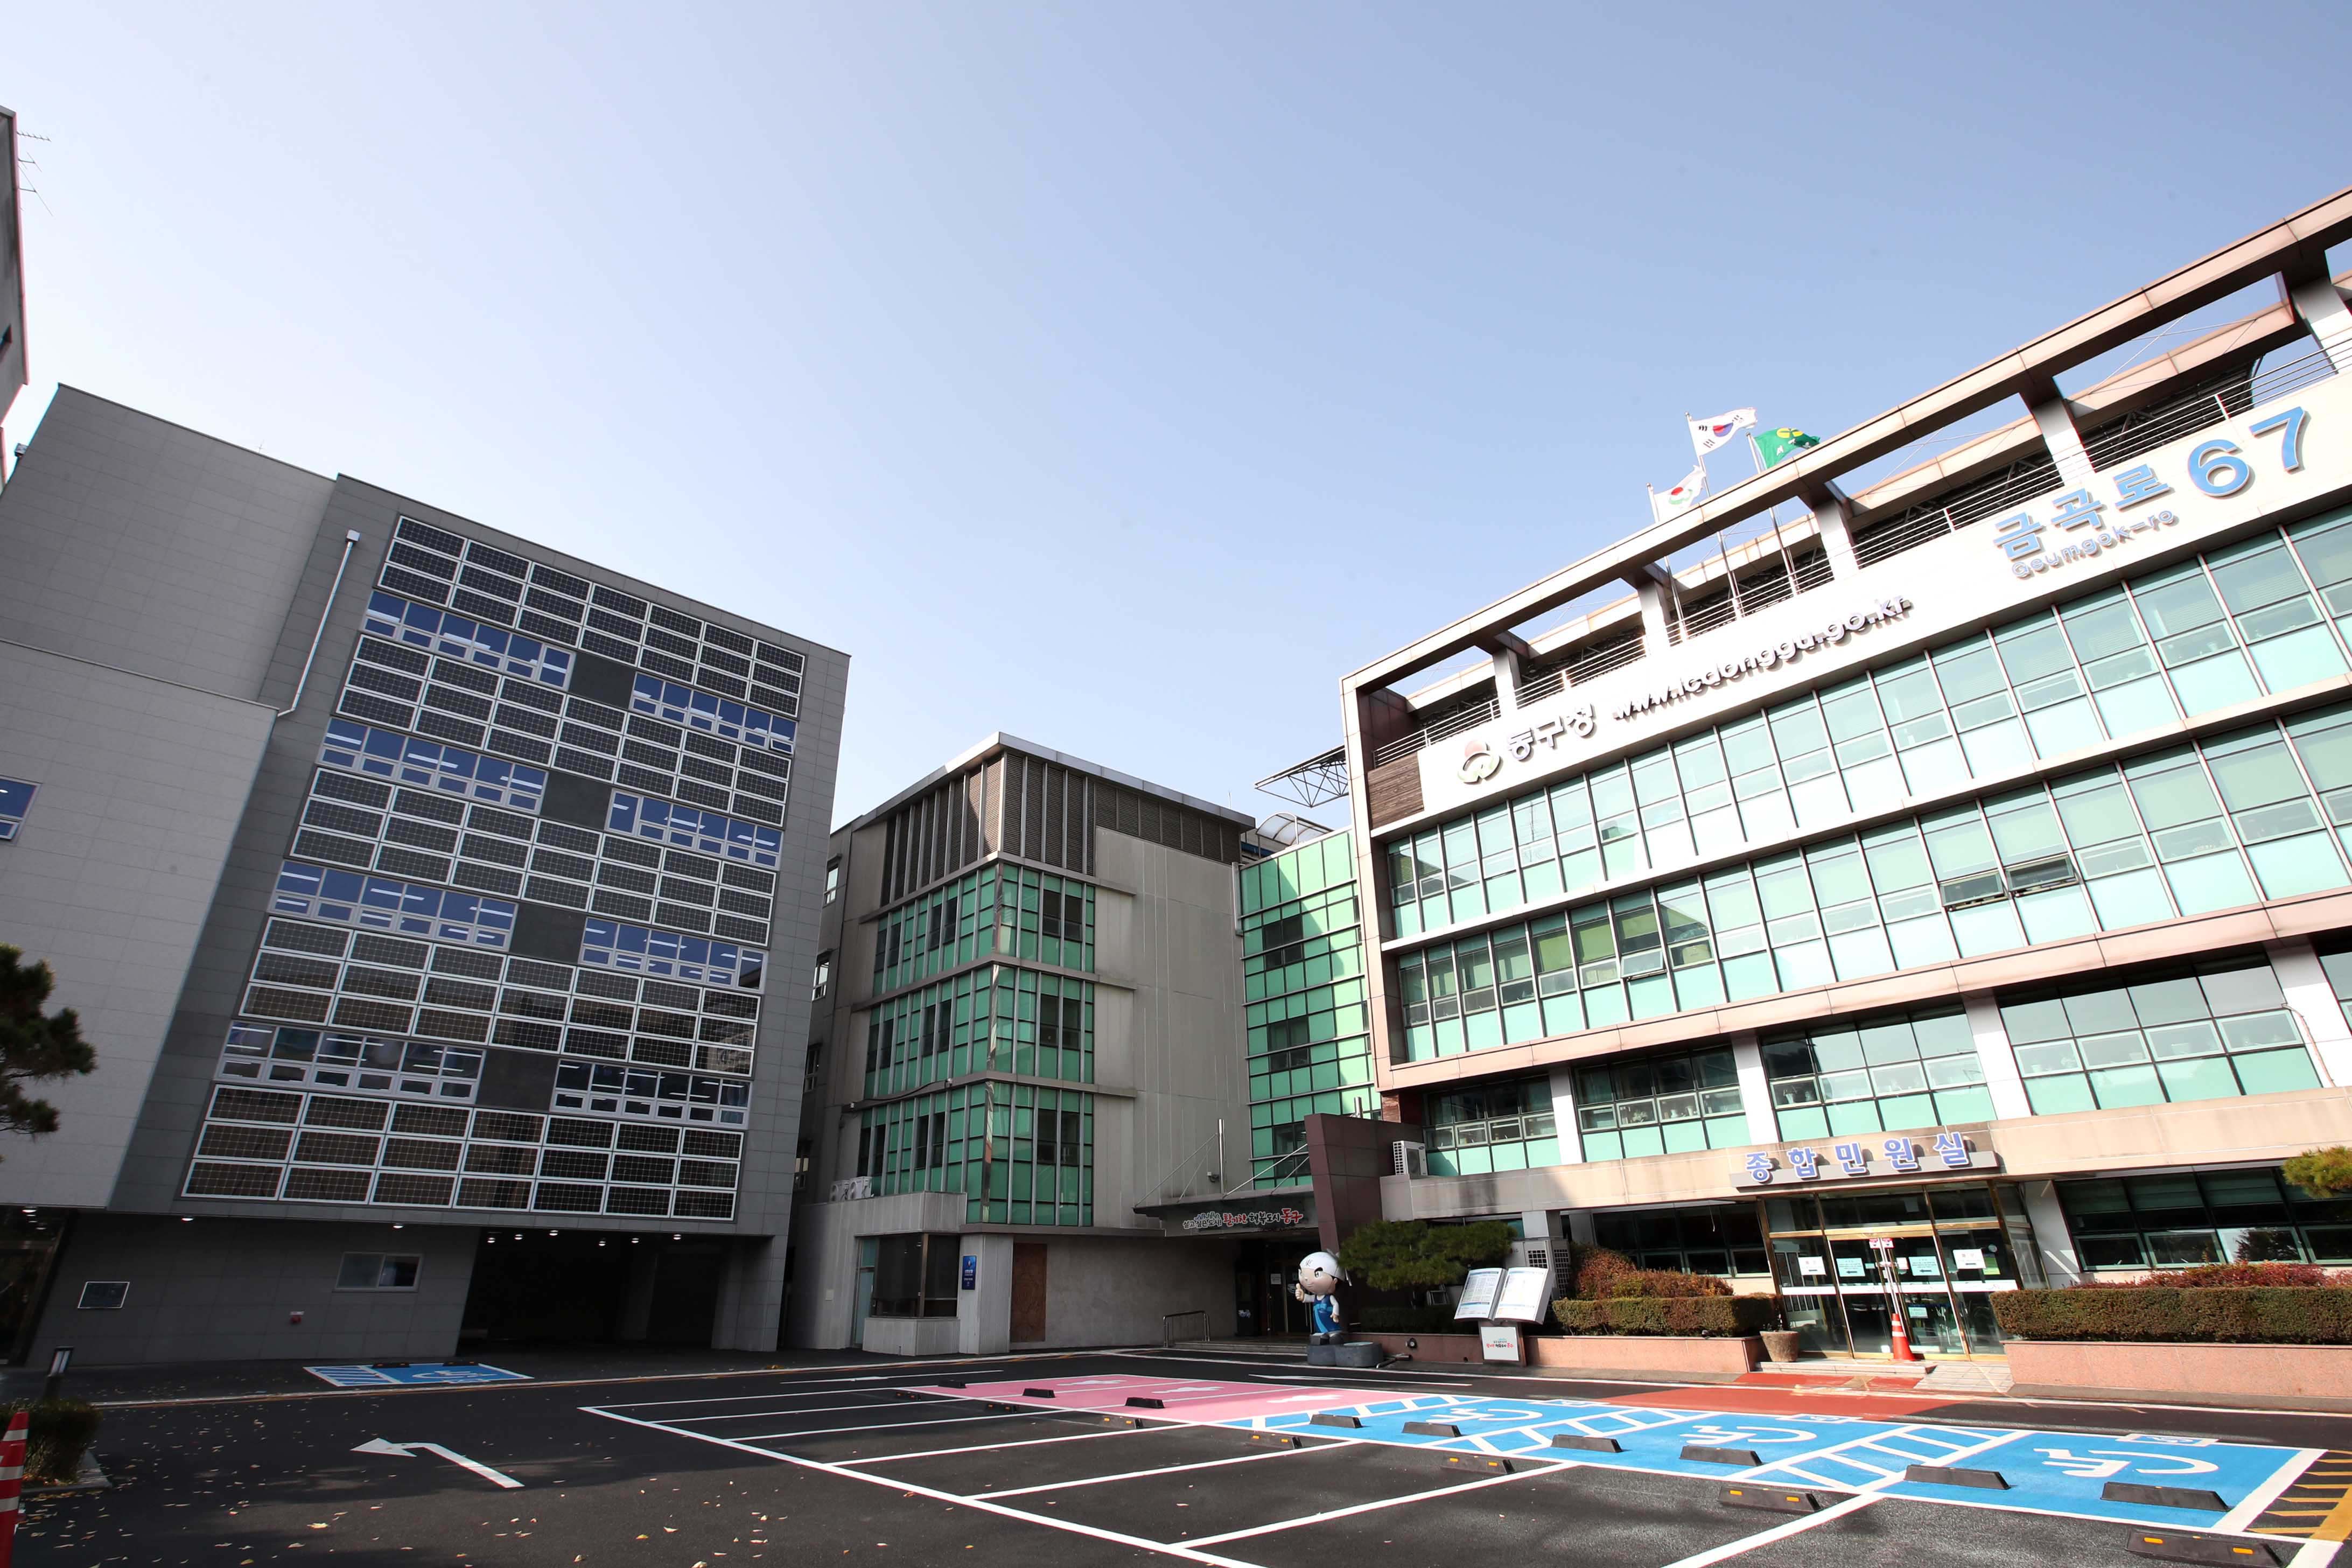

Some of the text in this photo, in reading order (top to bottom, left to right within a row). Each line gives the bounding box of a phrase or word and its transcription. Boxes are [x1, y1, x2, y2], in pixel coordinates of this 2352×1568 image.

[1993, 406, 2307, 561] 금곡로 67
[2012, 510, 2175, 578] Geumgok-ro
[1507, 702, 1595, 761] 동구청
[1745, 1131, 1970, 1184] 종합민원실
[1223, 1213, 1247, 1227] 활기찬
[1249, 1212, 1280, 1225] 행복도시
[1281, 1208, 1303, 1224] 동구
